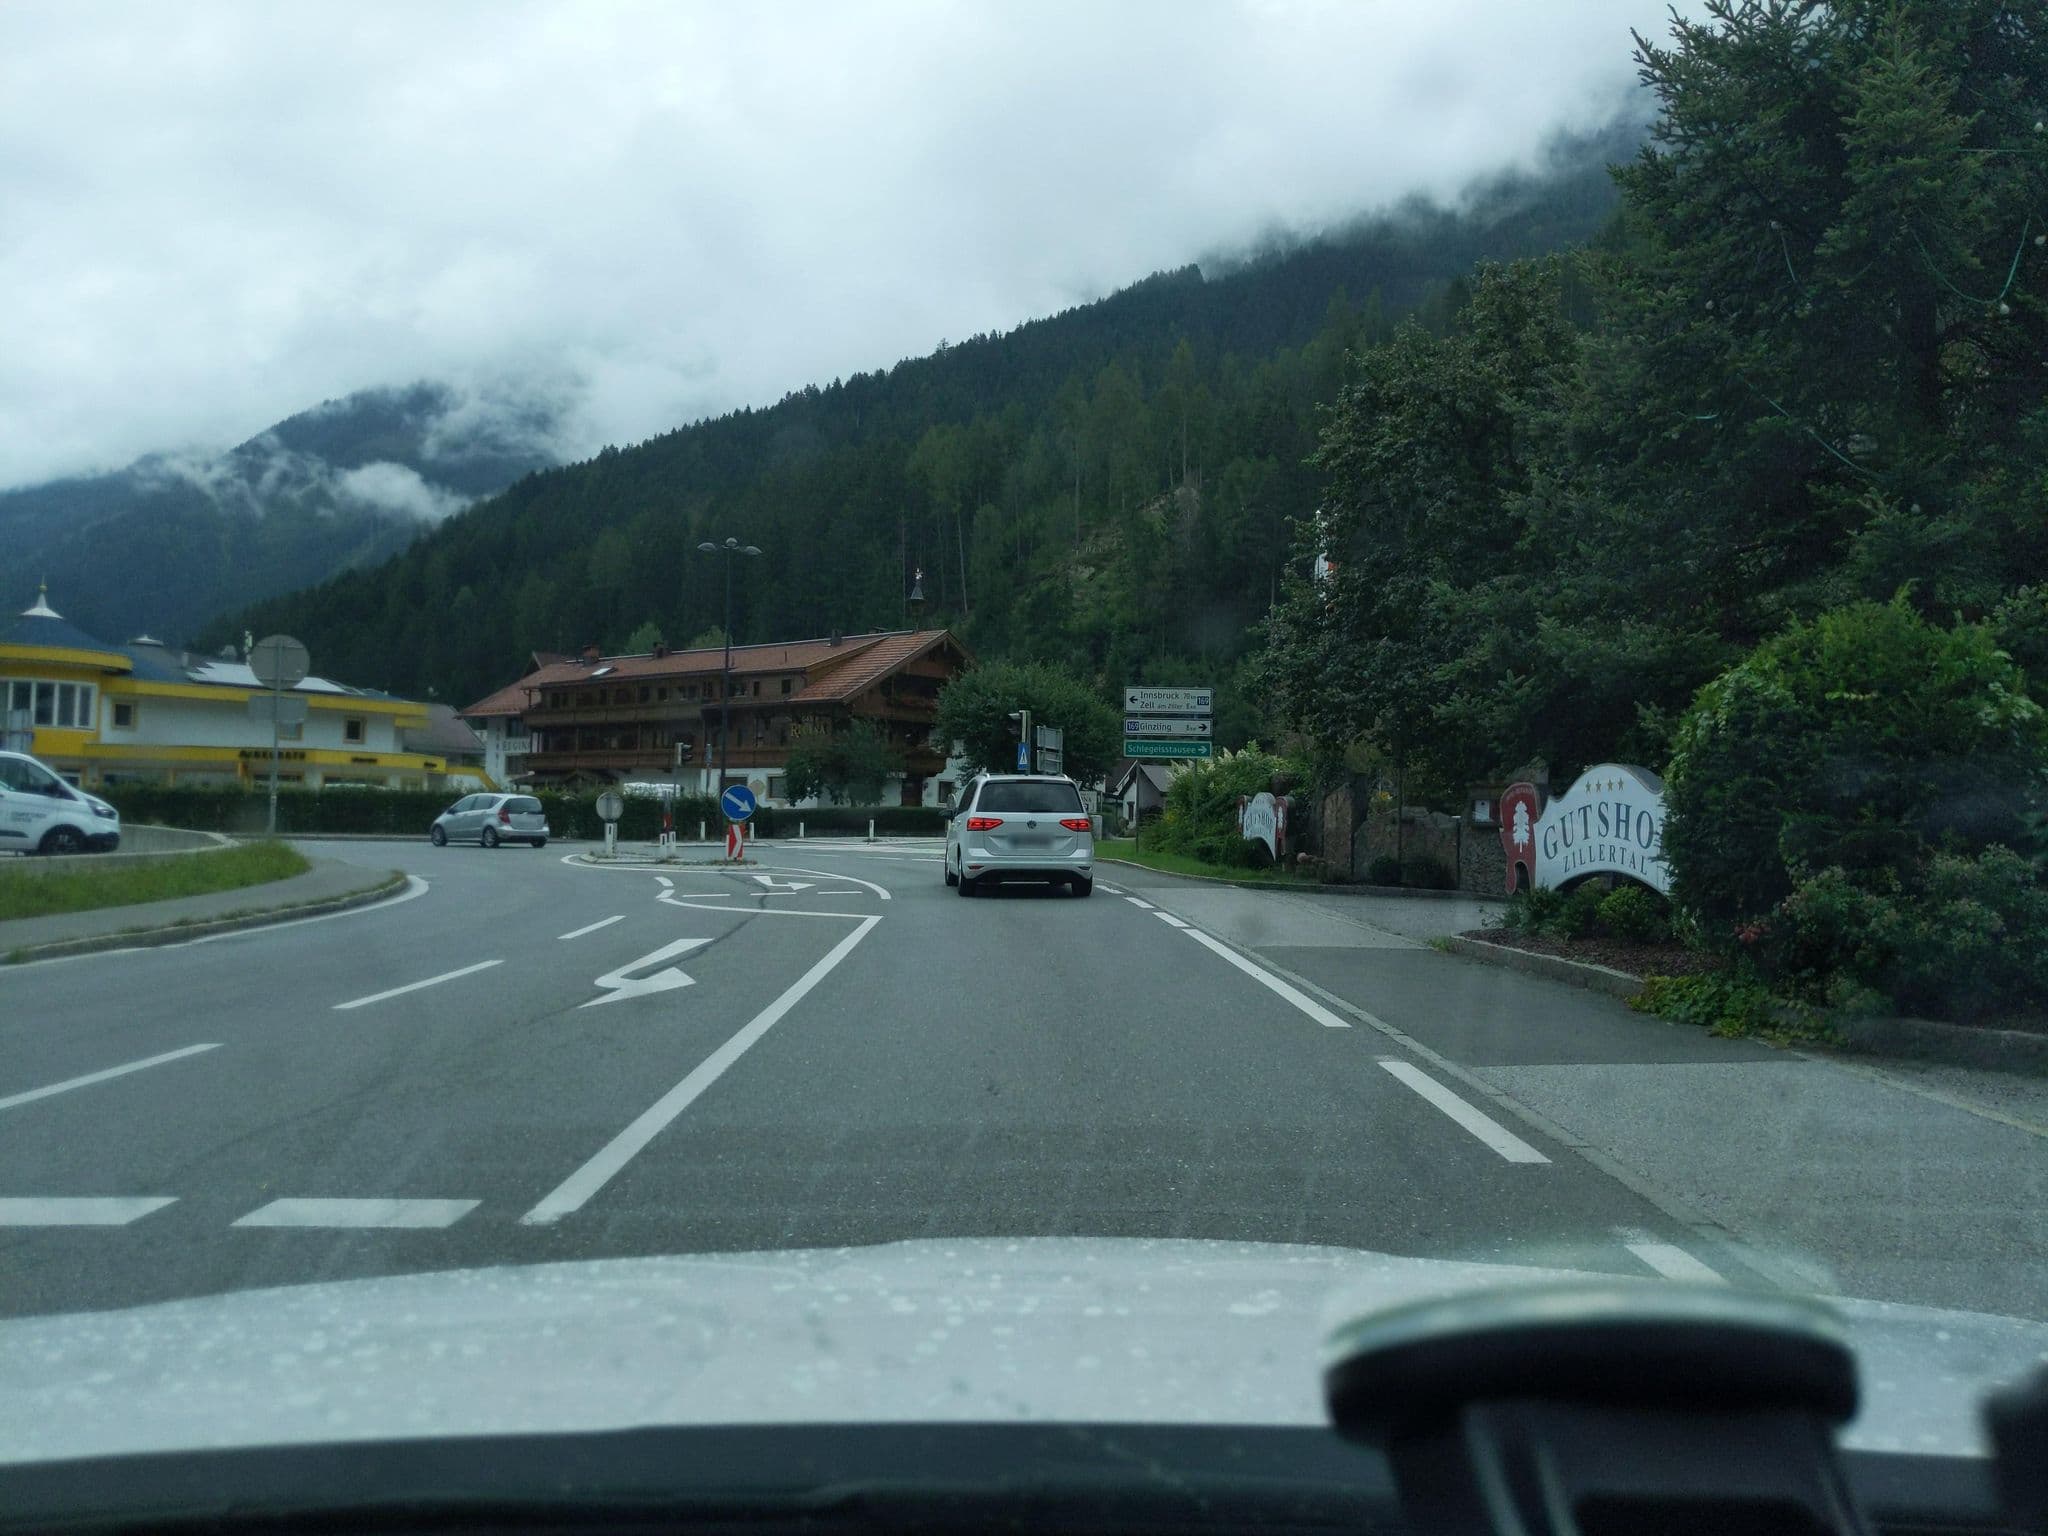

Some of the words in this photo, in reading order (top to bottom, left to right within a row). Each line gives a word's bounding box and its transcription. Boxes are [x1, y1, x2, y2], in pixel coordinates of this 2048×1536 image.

[1140, 691, 1179, 700] Innsbruck
[1140, 701, 1155, 709] Zell
[1198, 697, 1209, 705] 169
[1127, 721, 1139, 731] 169
[1140, 722, 1172, 732] Ginzling
[1128, 744, 1197, 754] Schlegeisstausee
[1563, 843, 1648, 876] ZILLERTAL
